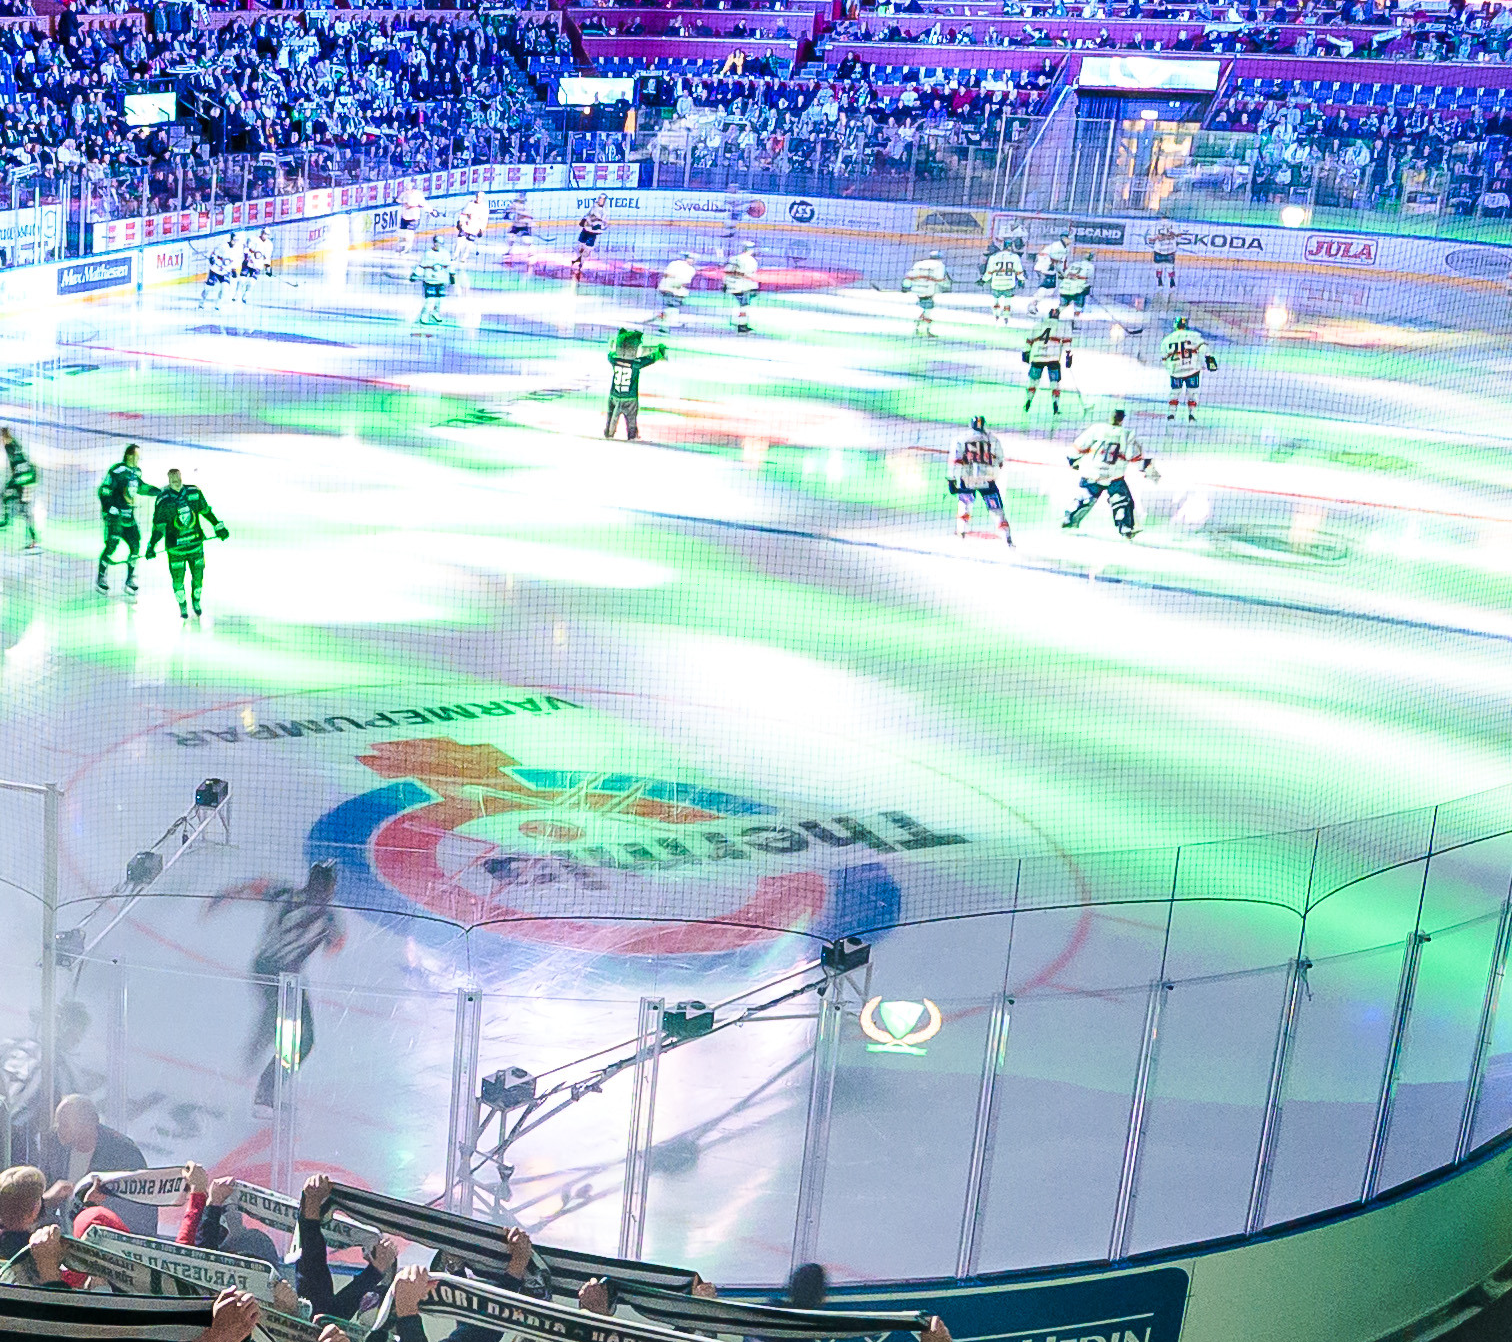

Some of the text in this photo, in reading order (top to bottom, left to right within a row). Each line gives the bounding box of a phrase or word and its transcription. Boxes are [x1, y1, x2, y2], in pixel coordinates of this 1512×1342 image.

[1308, 241, 1373, 260] JULA
[1039, 326, 1052, 345] 4
[166, 691, 583, 749] VÄRMEPUMPAR
